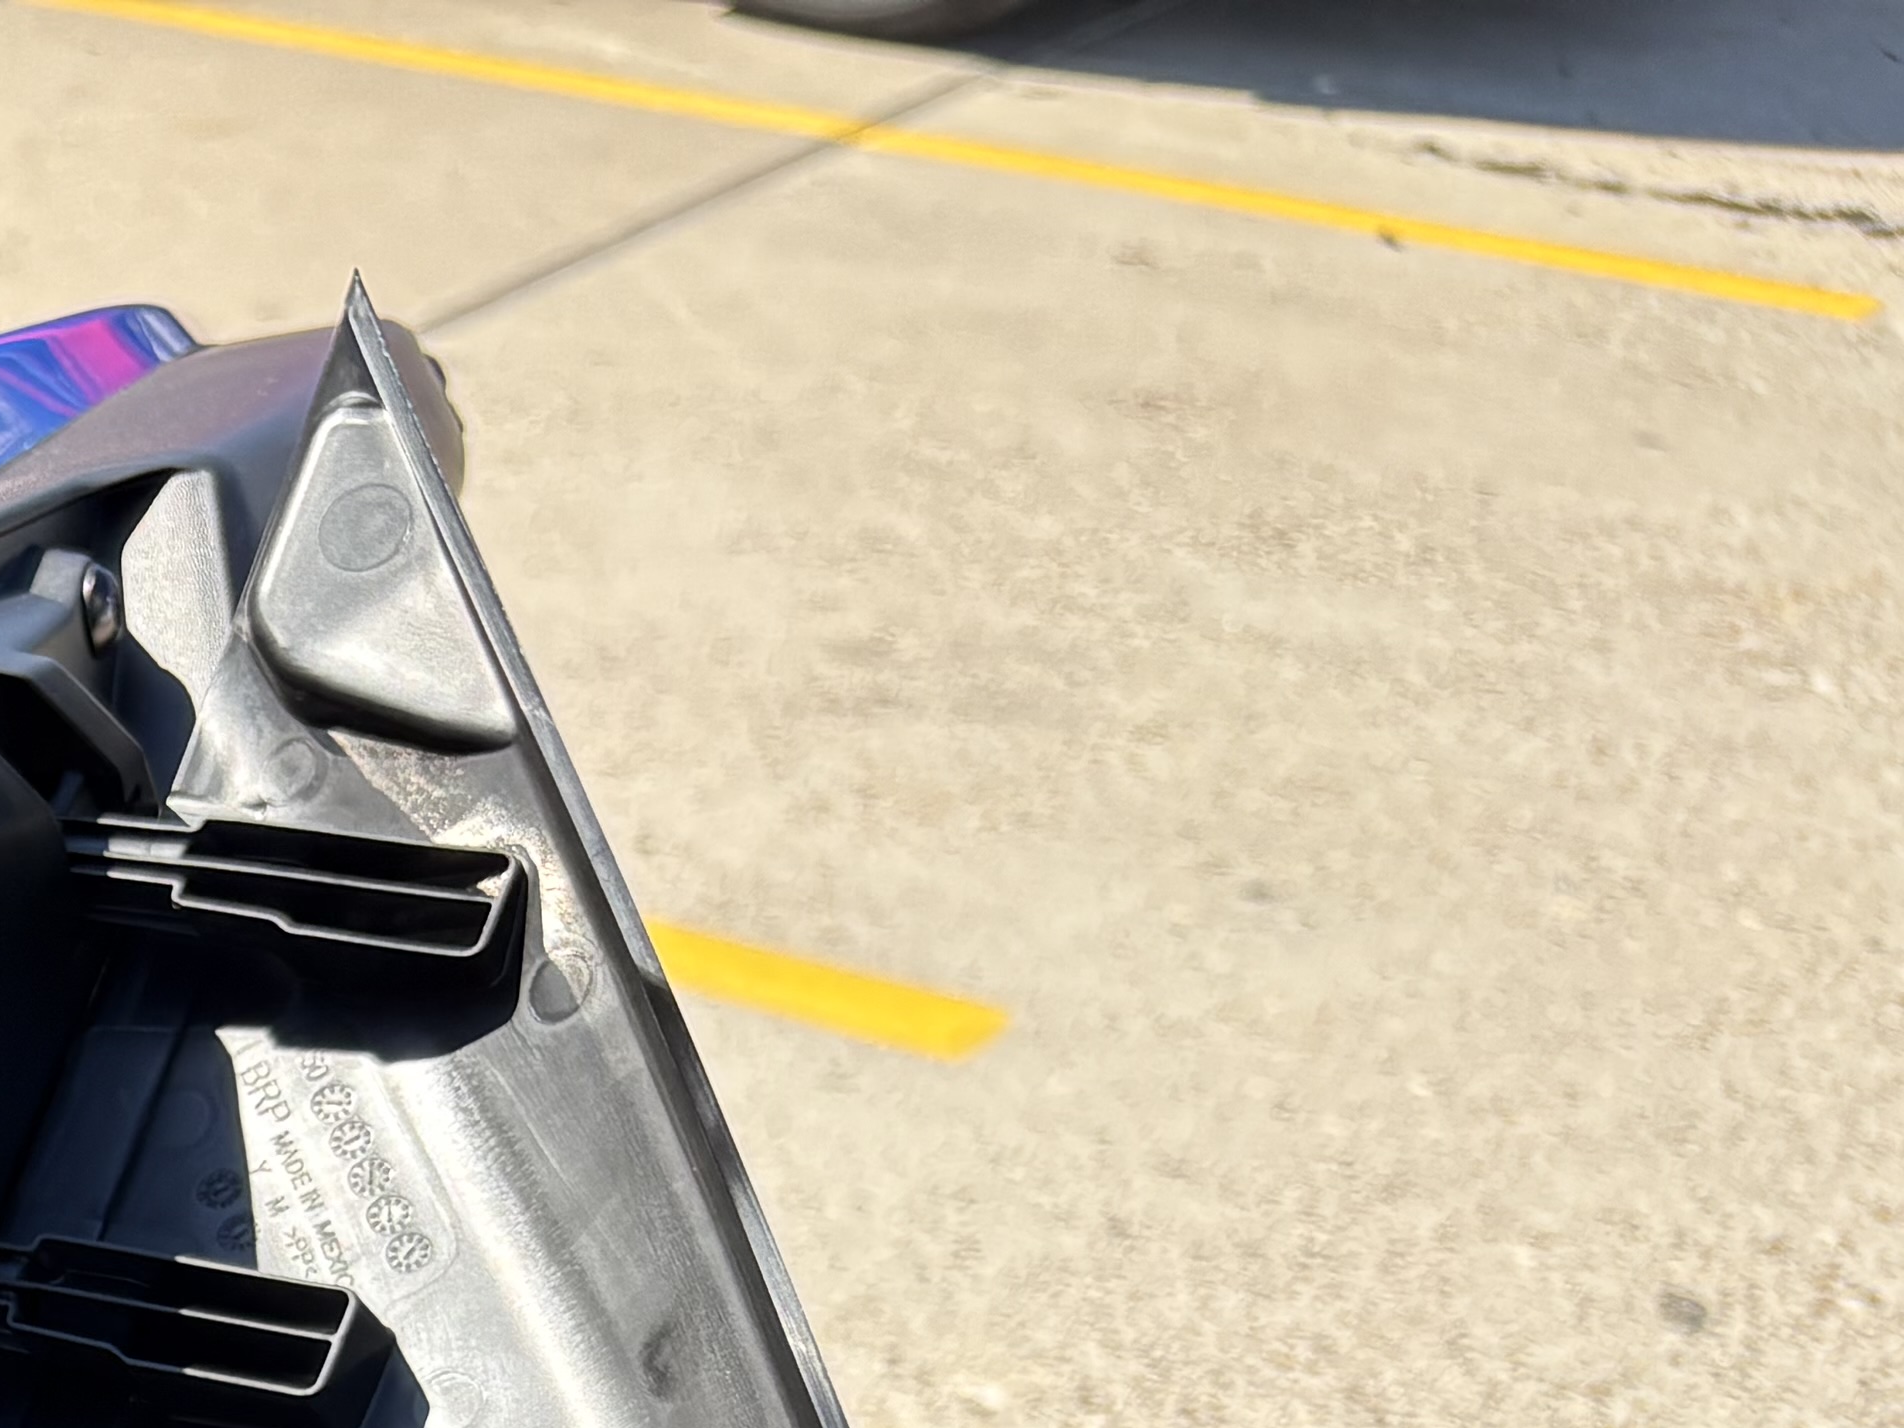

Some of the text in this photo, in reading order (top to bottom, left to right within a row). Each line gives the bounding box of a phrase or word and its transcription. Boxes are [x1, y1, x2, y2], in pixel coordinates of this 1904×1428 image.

[239, 1060, 355, 1287] BRP MADE IN MEXIC
